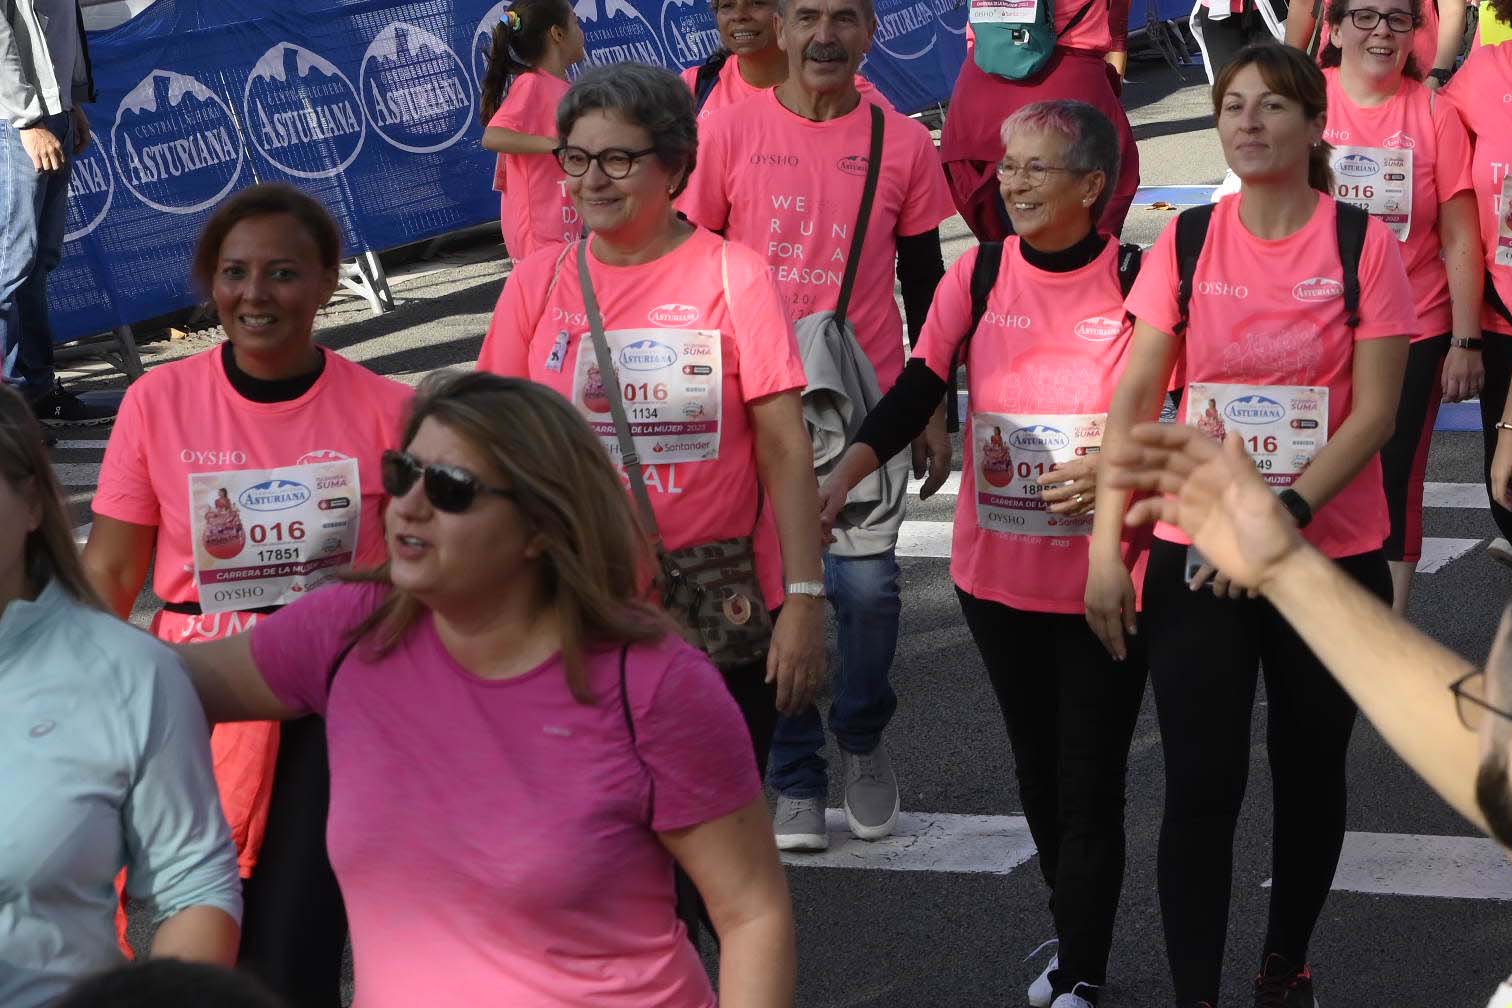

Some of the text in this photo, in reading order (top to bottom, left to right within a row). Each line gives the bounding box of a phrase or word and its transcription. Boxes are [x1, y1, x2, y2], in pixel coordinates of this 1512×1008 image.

[370, 77, 470, 127] ASTURIANA
[257, 99, 360, 149] ASTURIANA
[124, 126, 237, 186] ASTURIANA
[751, 154, 799, 167] OYSHO
[1339, 163, 1376, 172] ASTURIANA
[1338, 184, 1374, 198] 016
[772, 195, 805, 212] WE
[768, 242, 844, 263] FOR A
[1199, 281, 1248, 299] OYSHO
[623, 352, 673, 365] ASTURIANA
[683, 348, 712, 356] SUMA
[624, 382, 669, 402] 016
[1229, 406, 1280, 418] ASTURIANA
[1291, 402, 1317, 411] SUMA
[632, 407, 658, 420] 1134
[631, 423, 706, 434] DE LA MUJER 2023
[1075, 430, 1100, 439] SUMA
[665, 439, 710, 453] Santander
[1014, 434, 1064, 446] ASTURIANA
[180, 449, 246, 465] OYSHO
[316, 479, 347, 490] SUMA
[1264, 476, 1291, 484] MUJER
[245, 492, 305, 506] ASTURIANA
[990, 497, 1024, 508] CARRERA
[1025, 500, 1036, 508] DE
[989, 513, 1025, 526] OYSHO
[250, 521, 306, 543] 016
[257, 547, 300, 563] 17851
[216, 567, 291, 580] CARRERA DE LA
[214, 587, 264, 602] OYSHO
